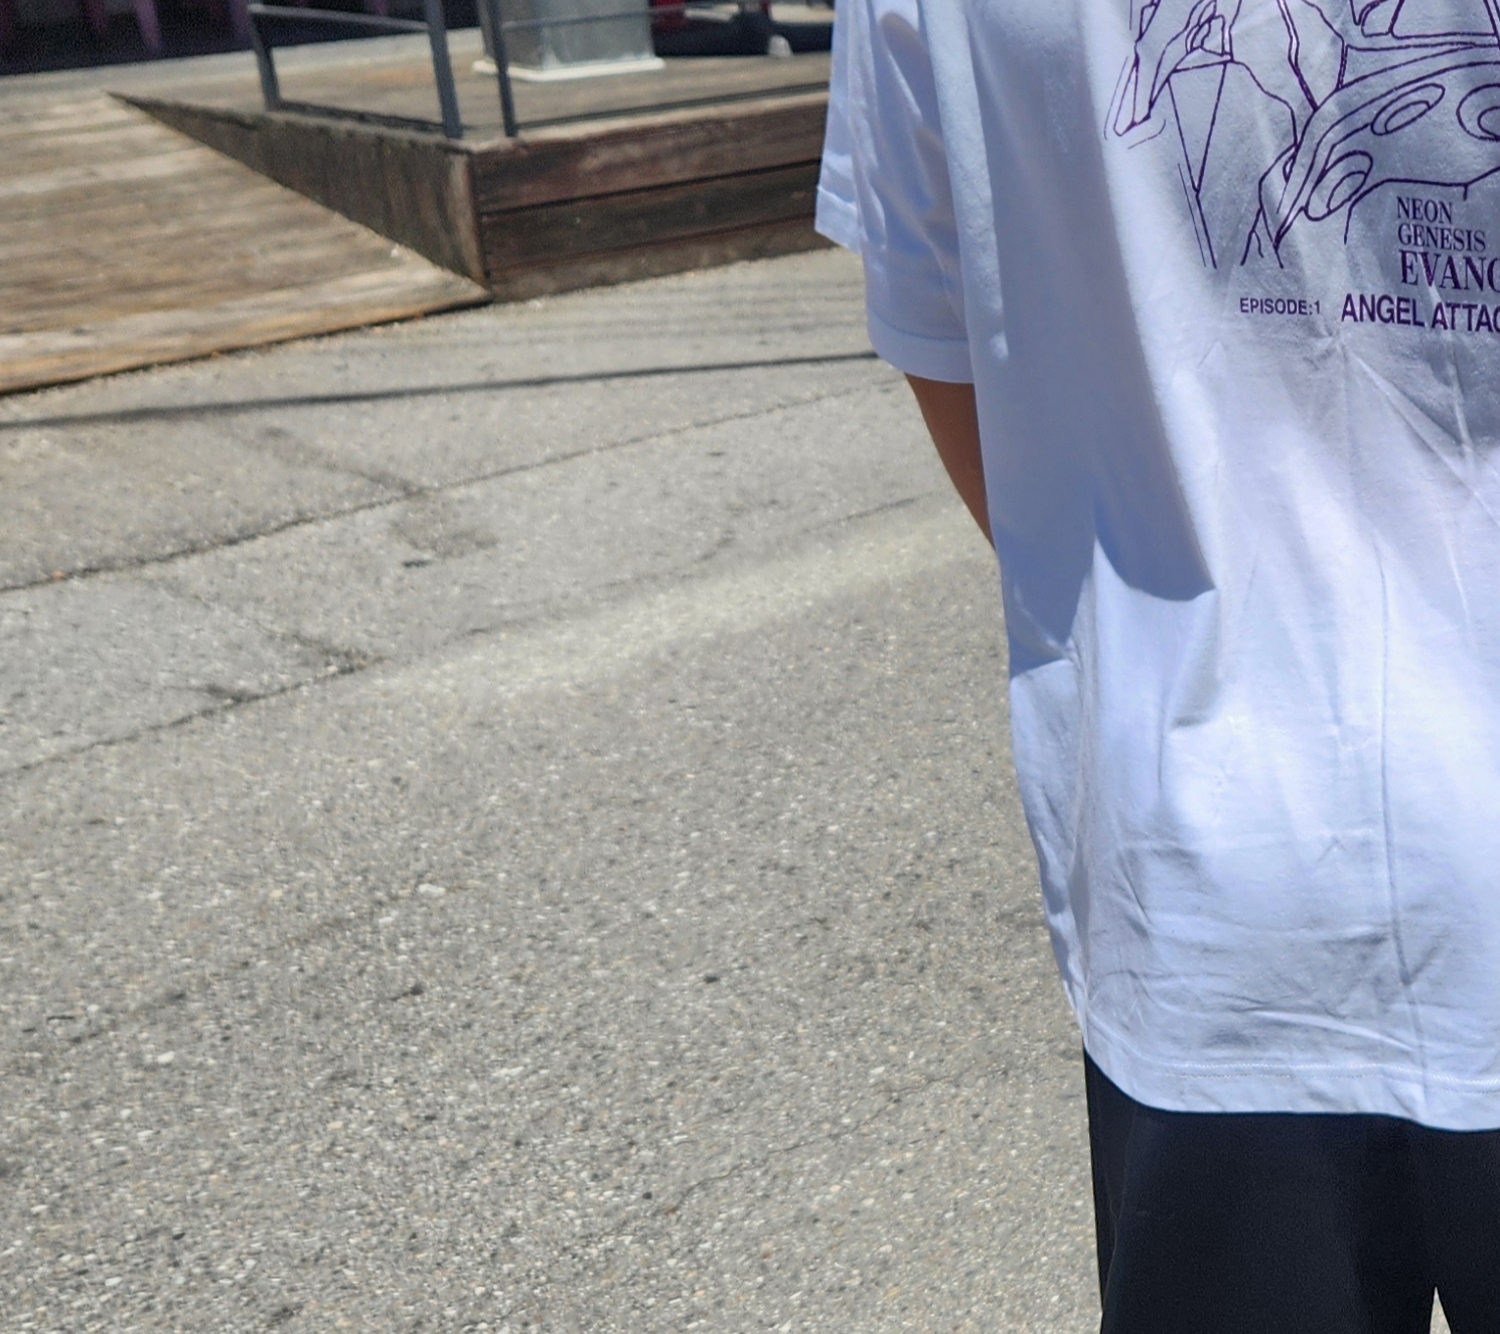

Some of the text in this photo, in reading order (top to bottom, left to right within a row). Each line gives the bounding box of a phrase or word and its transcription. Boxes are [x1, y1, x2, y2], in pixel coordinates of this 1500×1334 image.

[1396, 196, 1453, 225] NEON
[1397, 223, 1487, 253] GENESIS
[1340, 293, 1426, 328] ANGEL
